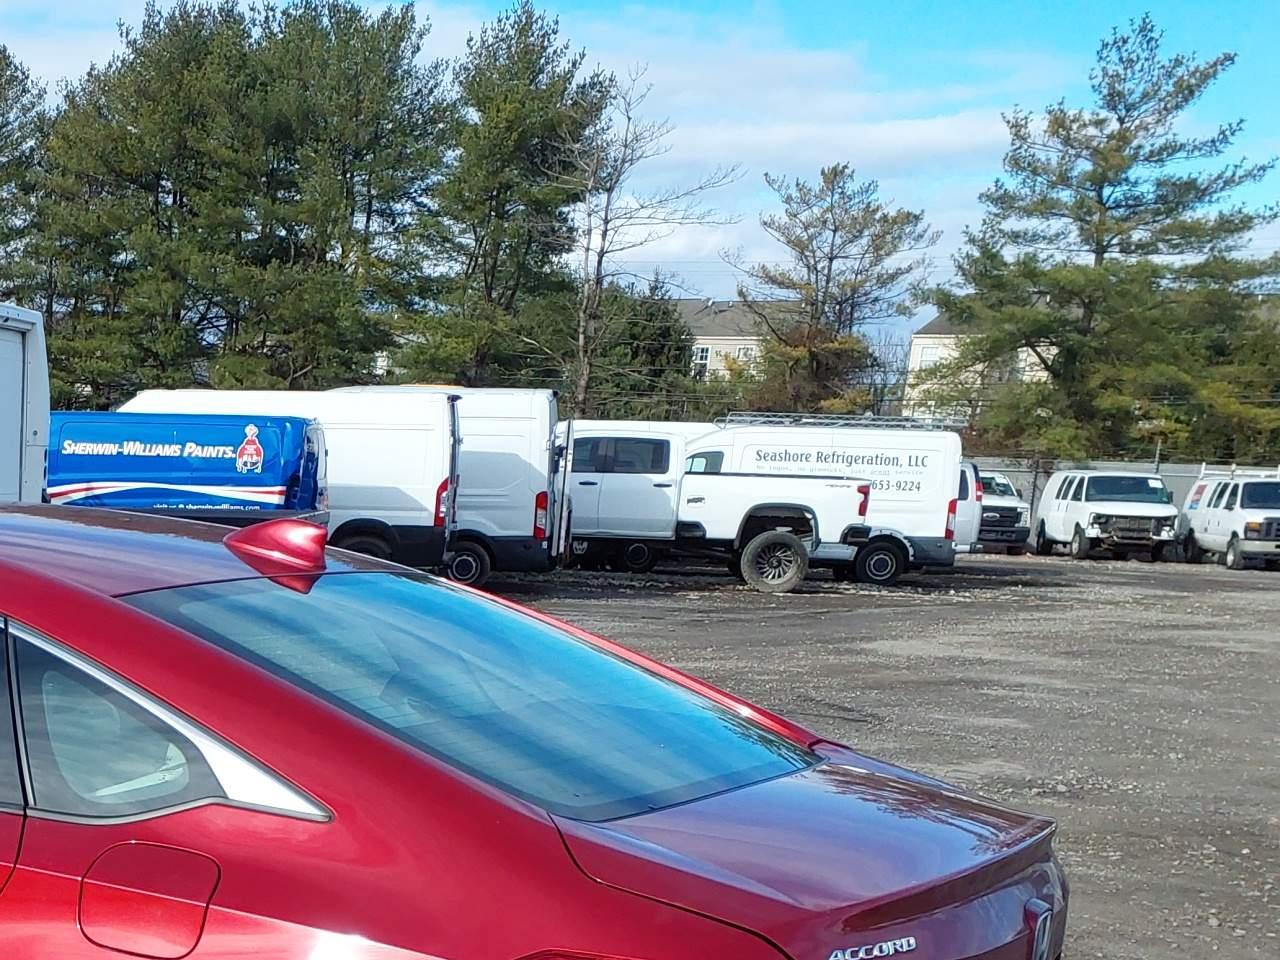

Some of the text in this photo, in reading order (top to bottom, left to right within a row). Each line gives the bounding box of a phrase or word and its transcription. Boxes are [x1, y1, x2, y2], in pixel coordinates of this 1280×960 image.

[62, 440, 181, 457] SHERWIN-WILLIAMS
[755, 449, 929, 468] Seashore Refrigeration, LLC
